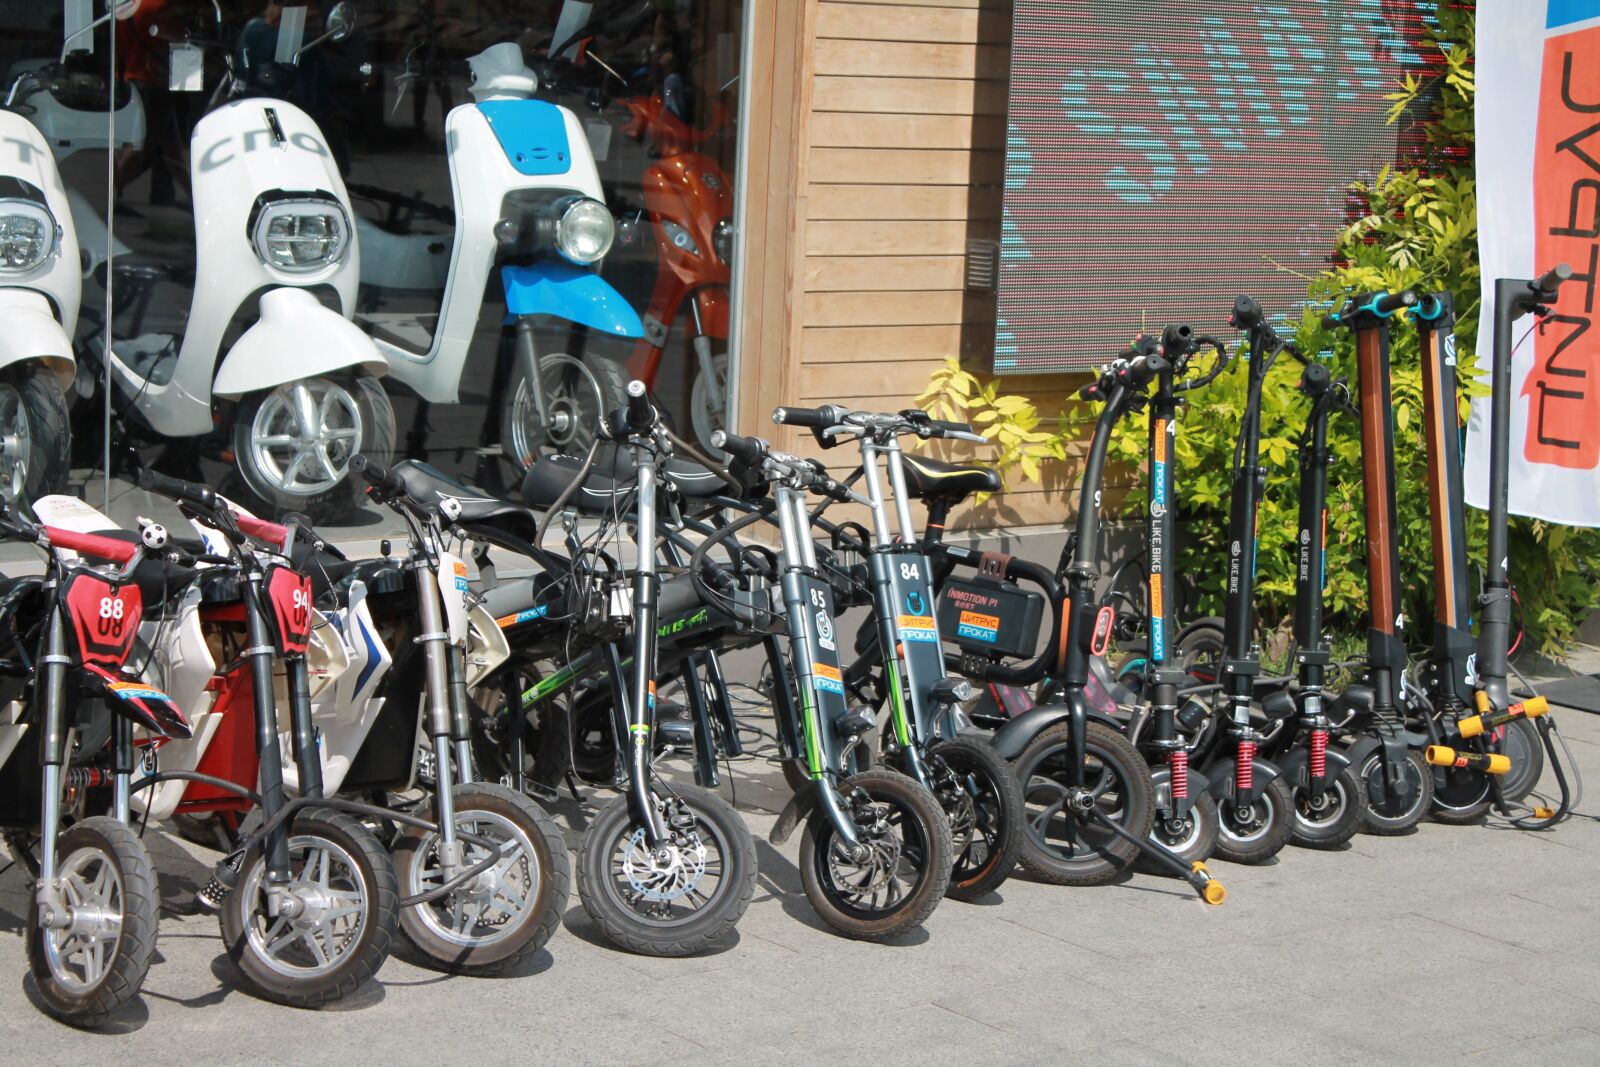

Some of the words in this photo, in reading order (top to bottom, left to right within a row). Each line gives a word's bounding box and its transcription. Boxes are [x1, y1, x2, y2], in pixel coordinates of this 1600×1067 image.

[1156, 463, 1164, 501] ПРОКАТ
[900, 562, 920, 580] 84
[293, 588, 308, 611] 94
[810, 587, 826, 608] 85
[947, 586, 988, 605] INMOTION
[1151, 575, 1161, 616] ЦИТРУС
[99, 597, 124, 620] 88
[961, 612, 998, 628] ЦИТРУС
[900, 630, 937, 640] ПРОКАТ
[959, 625, 995, 639] ПРОКАТ
[1153, 618, 1163, 658] ПРОКАТ
